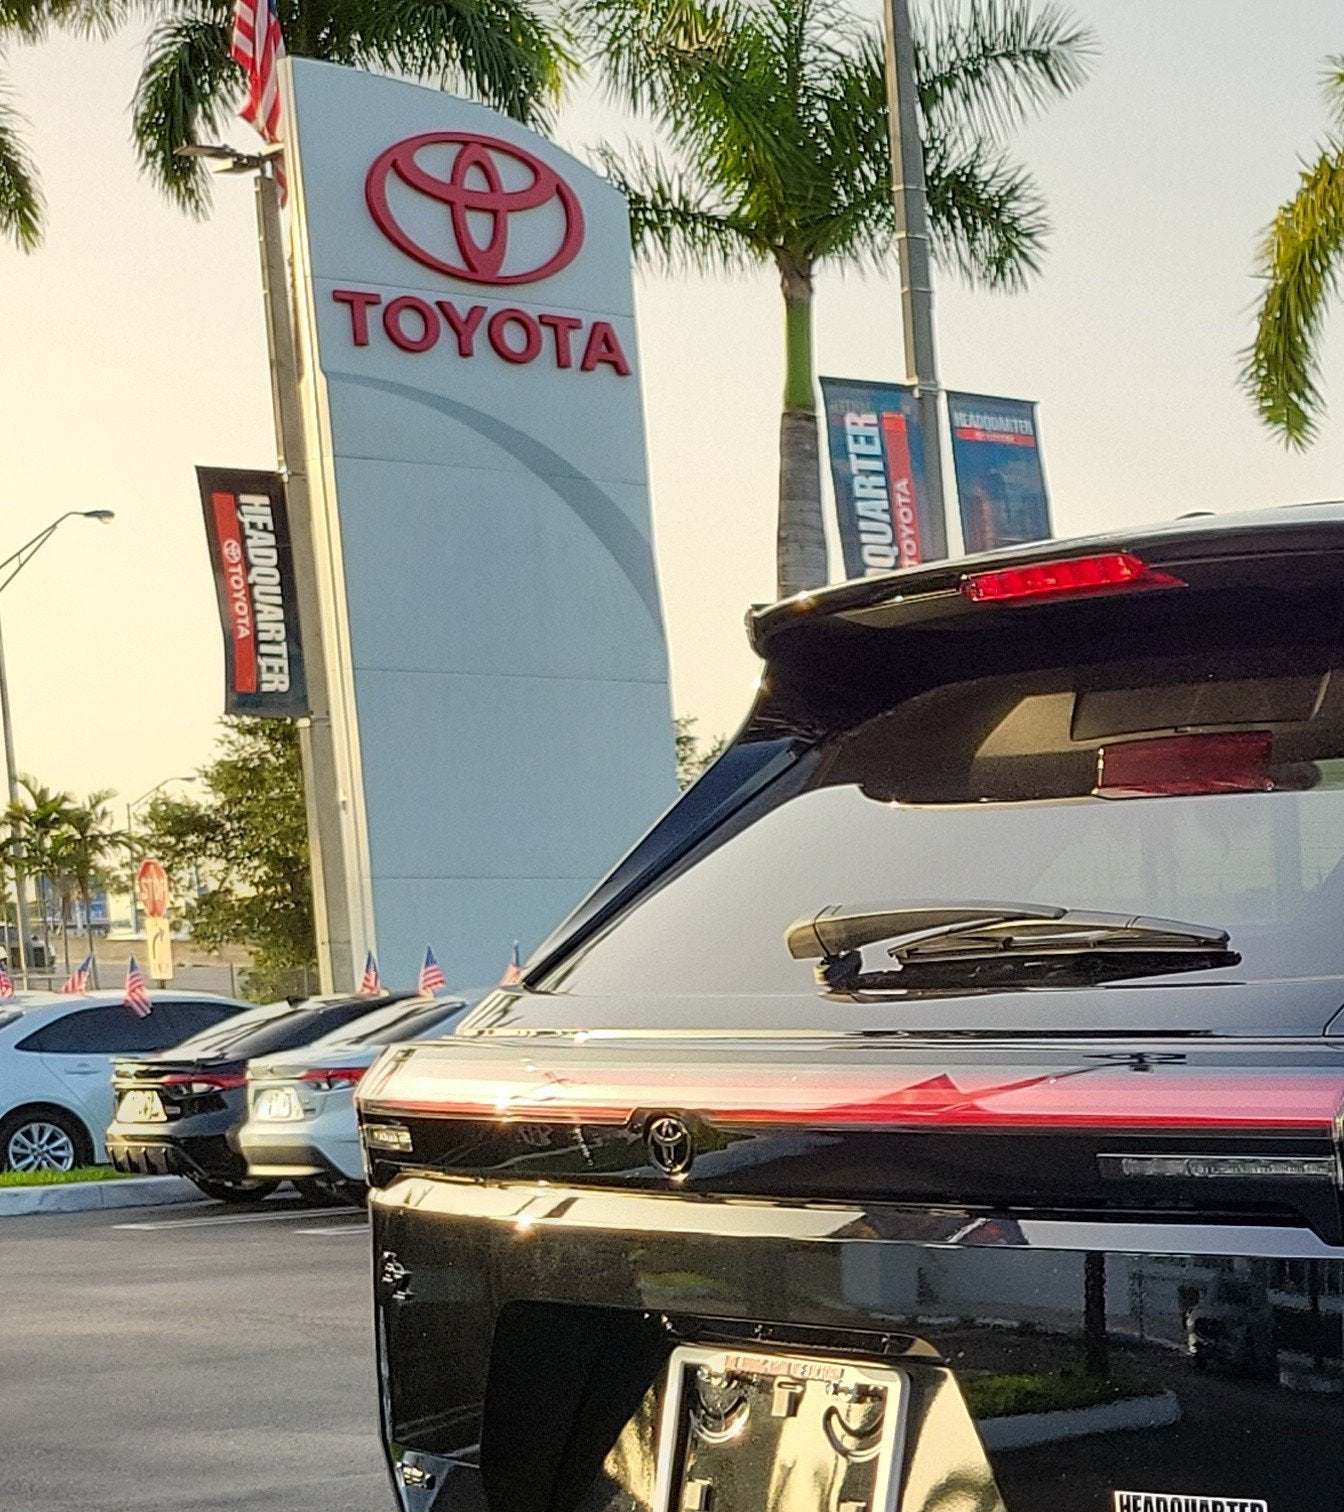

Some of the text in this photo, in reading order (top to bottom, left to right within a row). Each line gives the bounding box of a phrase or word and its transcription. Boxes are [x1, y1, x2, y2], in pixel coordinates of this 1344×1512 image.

[332, 289, 632, 377] TOYOTA
[227, 566, 251, 640] TOYOTA
[237, 493, 291, 693] HEADQUARTER
